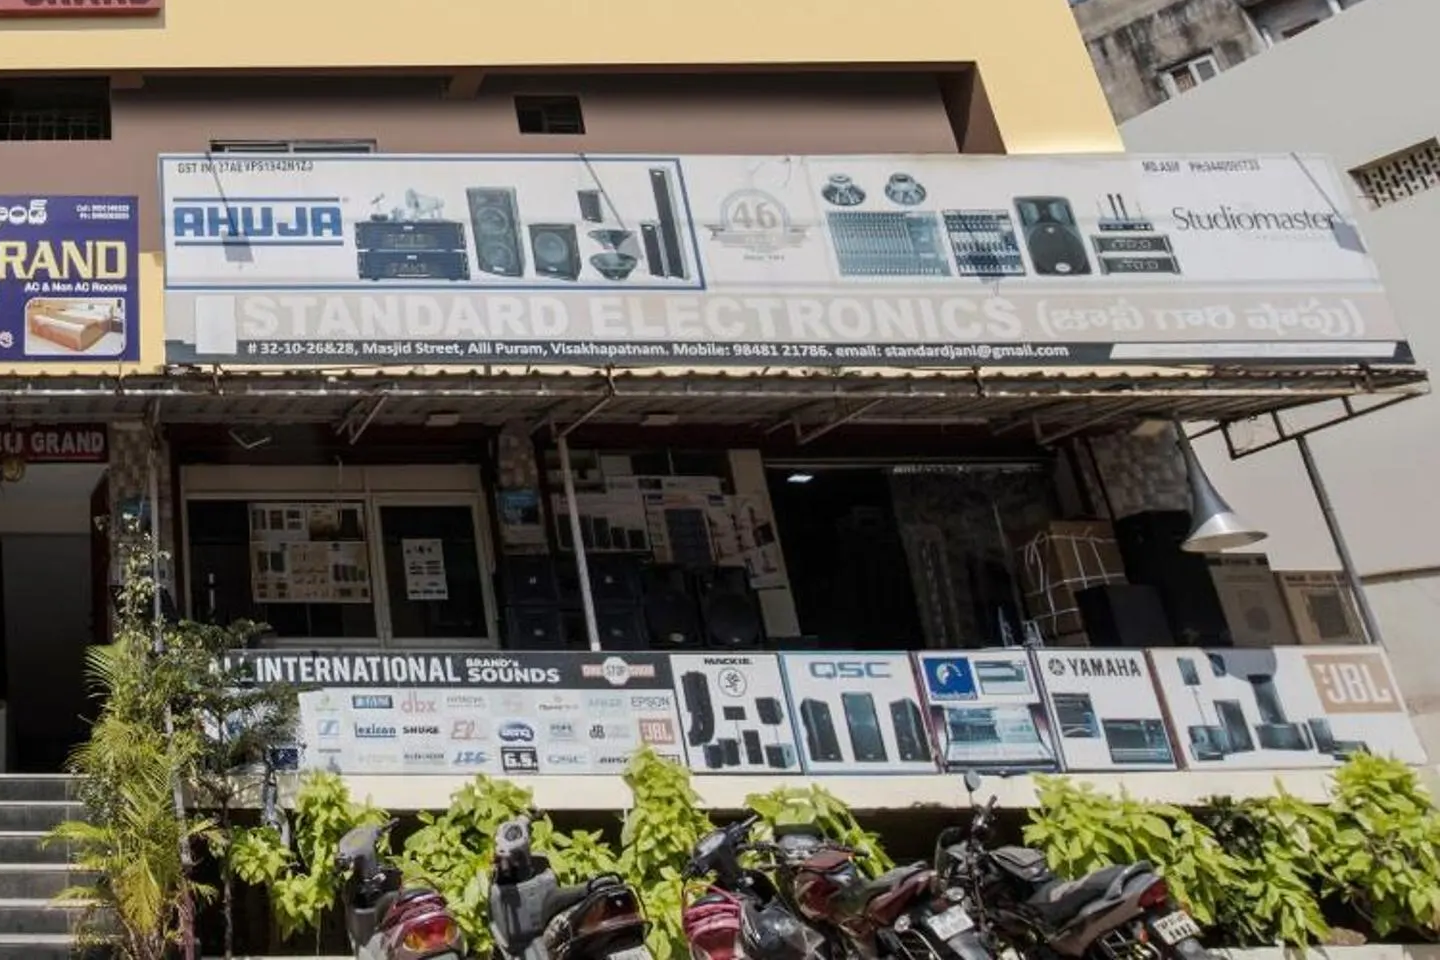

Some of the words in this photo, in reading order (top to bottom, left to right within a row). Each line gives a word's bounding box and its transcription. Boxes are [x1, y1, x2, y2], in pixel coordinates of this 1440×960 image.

[173, 206, 343, 237] AHUJA
[732, 201, 777, 229] 46
[1172, 205, 1336, 231] Studiomaster
[242, 295, 570, 338] STANDARD
[589, 297, 1023, 339] ELECTRONICS
[248, 342, 256, 354] #
[363, 341, 412, 357] Masjid
[495, 342, 548, 357] Puram,
[550, 342, 670, 358] Visakhapatnam.
[673, 343, 730, 356] Mobile:
[835, 344, 882, 357] email:
[885, 344, 1070, 359] standardjani@gmail.com
[30, 431, 104, 454] GRAND
[257, 657, 461, 684] INTERNATIONAL
[467, 667, 561, 685] SOUNDS
[809, 661, 892, 679] QSC
[1067, 656, 1142, 678] YAMAHA
[1318, 662, 1394, 704] JBL
[401, 692, 438, 714] dbx
[631, 696, 671, 708] EPSON
[403, 727, 441, 735] SHURE
[642, 721, 673, 742] JBL
